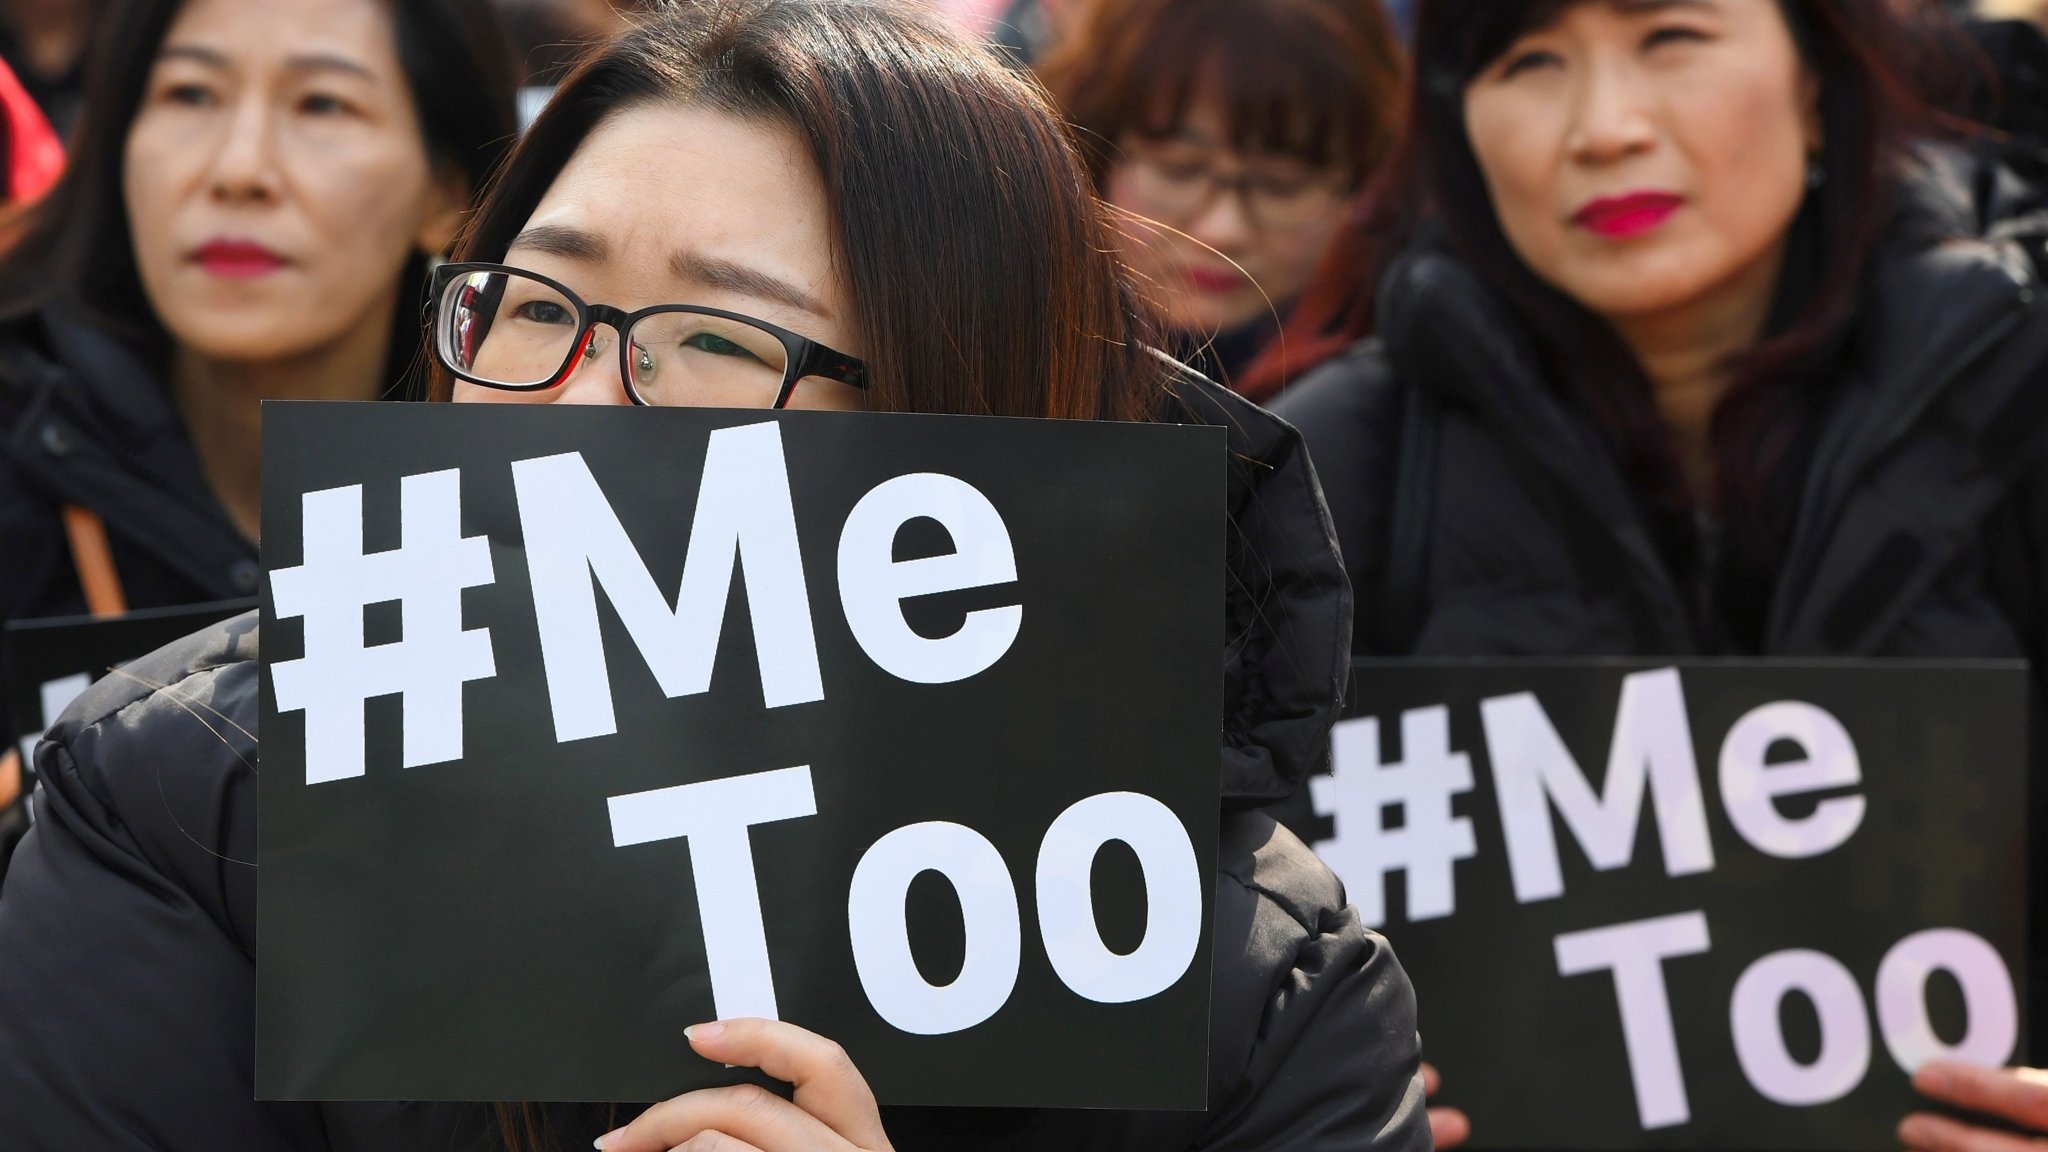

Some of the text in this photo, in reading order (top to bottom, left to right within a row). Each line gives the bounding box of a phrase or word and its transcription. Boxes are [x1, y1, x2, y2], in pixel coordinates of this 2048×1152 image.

[268, 420, 1023, 786] #Me
[606, 764, 1203, 1069] Too
[1308, 667, 1867, 929] #Me
[1553, 910, 2018, 1131] Too
